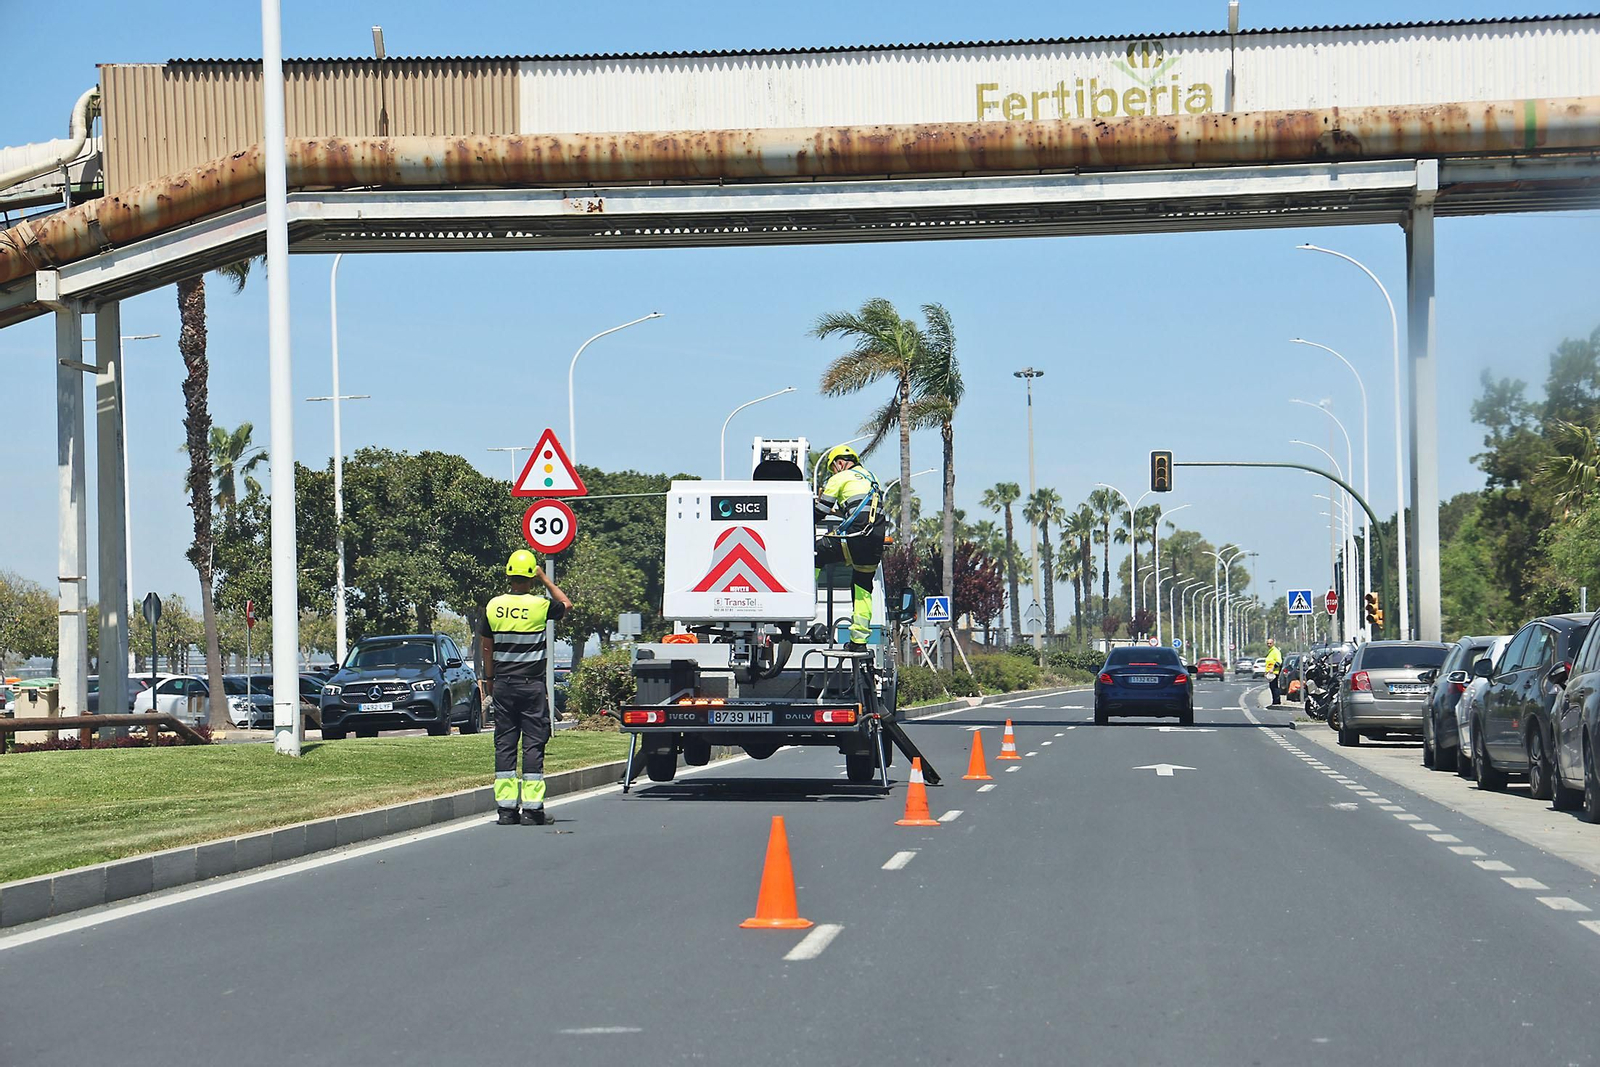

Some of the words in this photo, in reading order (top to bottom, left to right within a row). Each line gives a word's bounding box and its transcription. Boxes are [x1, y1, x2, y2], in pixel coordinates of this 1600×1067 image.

[976, 74, 1213, 121] Fertiberia
[735, 503, 760, 513] SICE
[534, 517, 564, 535] 30
[724, 598, 757, 606] TransTel
[495, 606, 529, 620] SICE
[714, 712, 744, 723] 8739
[748, 712, 770, 723] MHT
